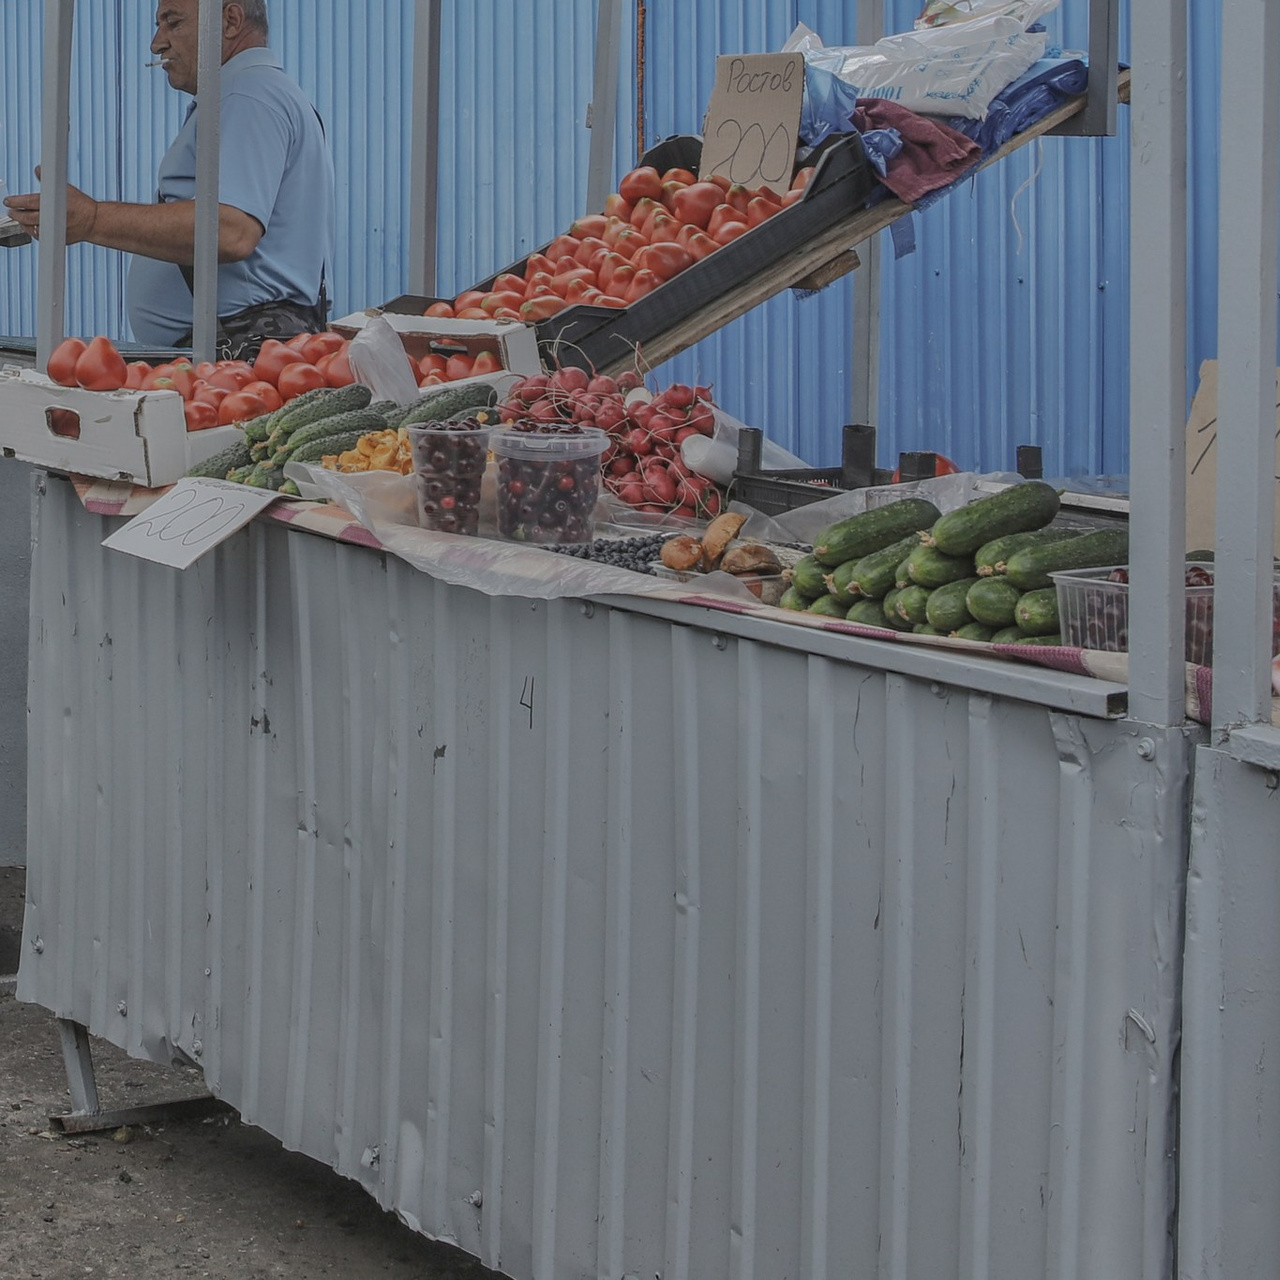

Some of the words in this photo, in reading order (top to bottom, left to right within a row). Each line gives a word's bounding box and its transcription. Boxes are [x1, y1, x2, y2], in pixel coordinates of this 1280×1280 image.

[726, 58, 796, 94] Ростов
[709, 118, 790, 185] 200
[127, 488, 246, 547] 200
[519, 675, 535, 730] 4
